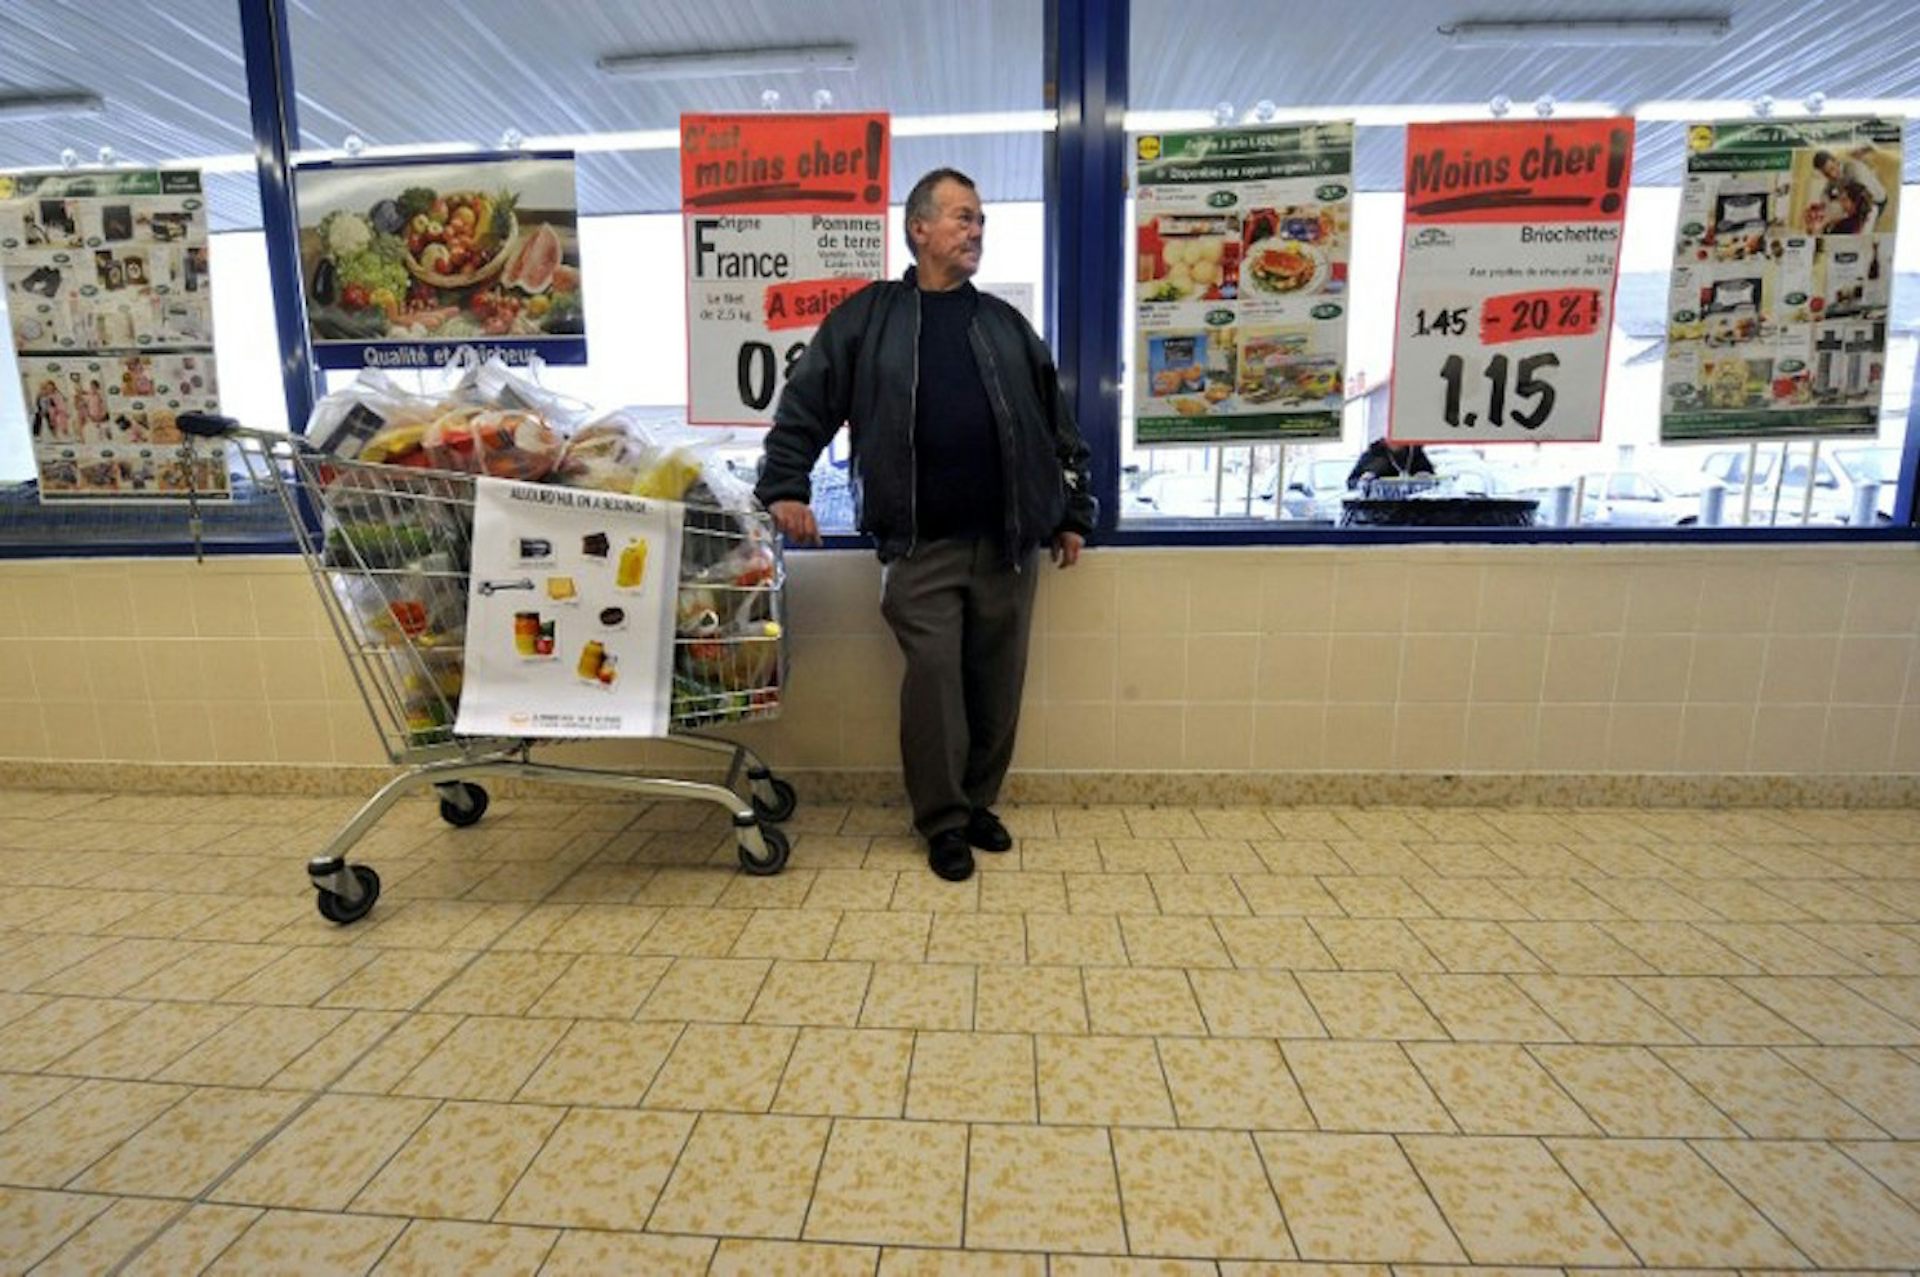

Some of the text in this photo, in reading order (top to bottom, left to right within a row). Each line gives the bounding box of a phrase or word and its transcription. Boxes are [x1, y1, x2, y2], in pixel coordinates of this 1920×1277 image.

[696, 150, 785, 187] moins
[1408, 149, 1510, 196] Moins
[812, 215, 881, 231] Pommes
[1521, 225, 1618, 244] Briochettes
[695, 219, 788, 278] France
[817, 233, 880, 248] de terre
[767, 292, 786, 320] A
[1510, 299, 1550, 332] 20
[1558, 295, 1582, 327] %
[363, 346, 428, 367] Qualité
[1440, 351, 1561, 430] 1.15
